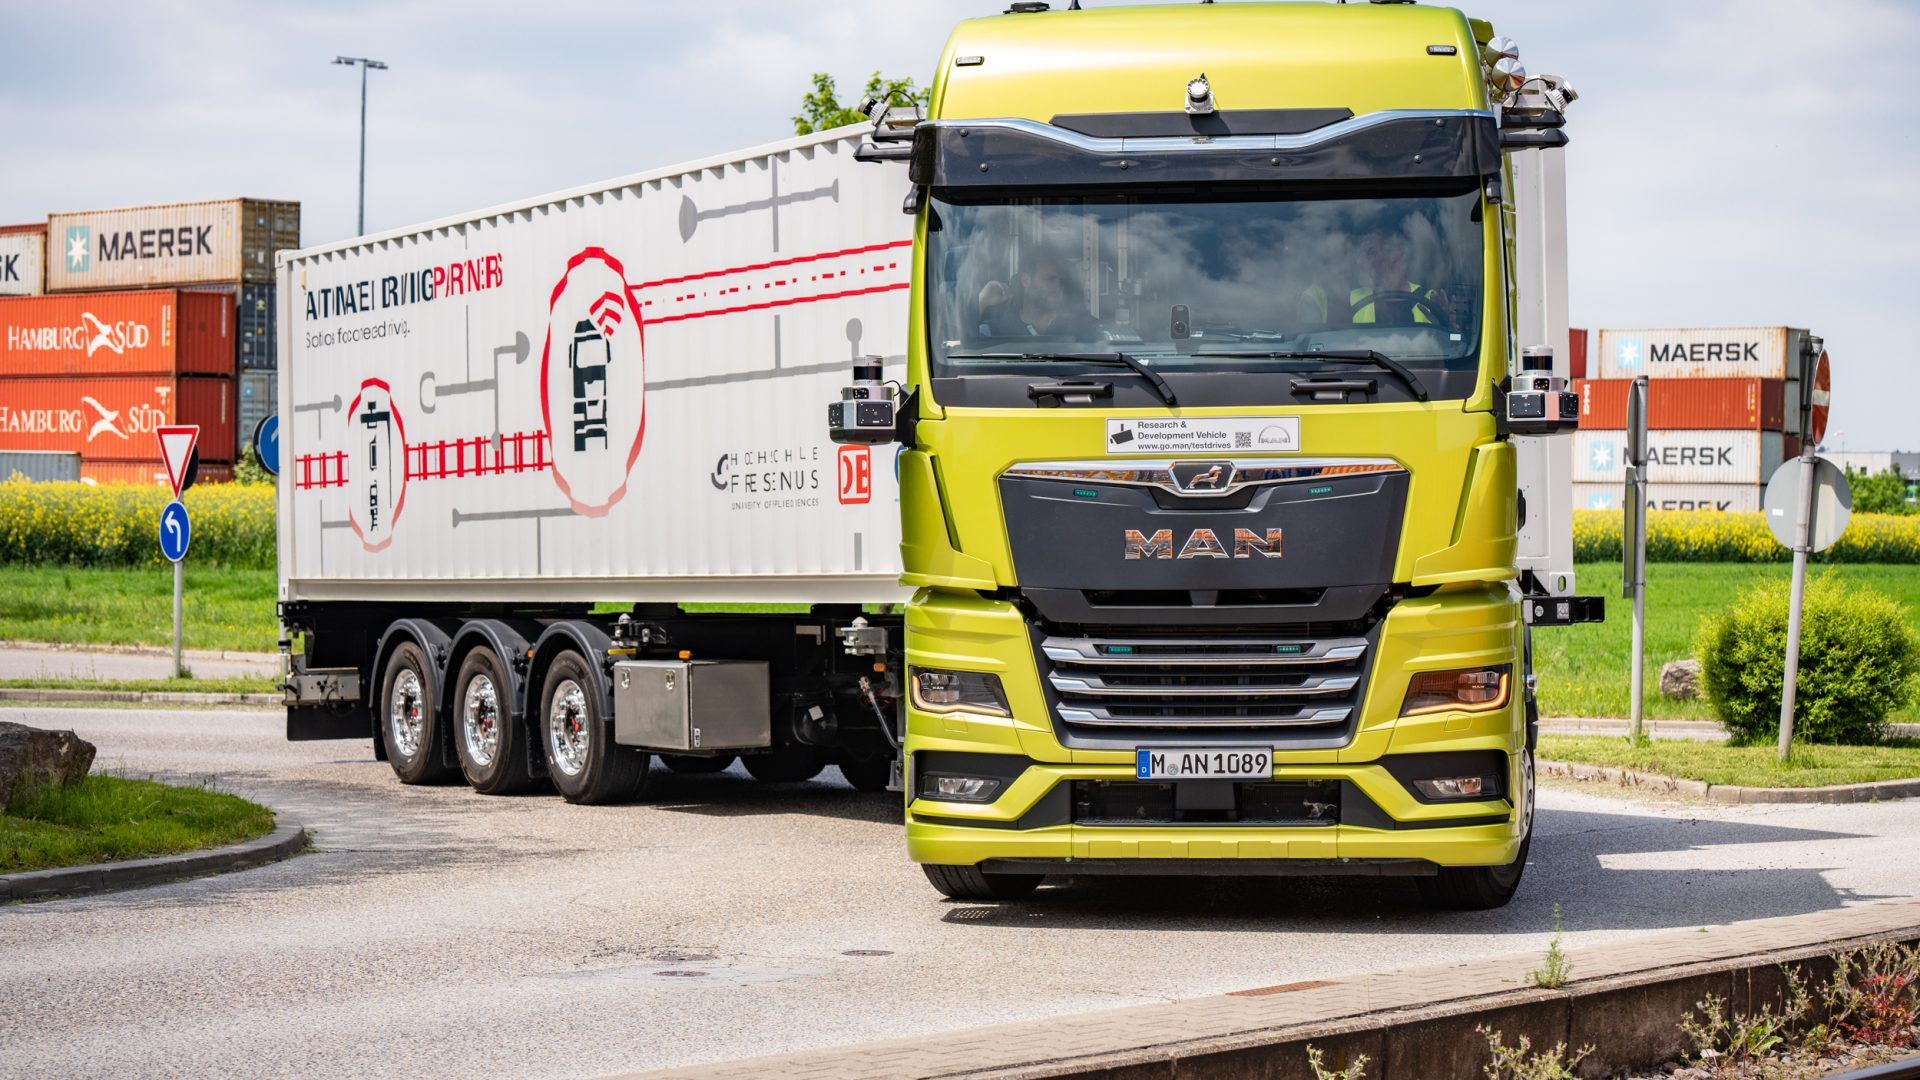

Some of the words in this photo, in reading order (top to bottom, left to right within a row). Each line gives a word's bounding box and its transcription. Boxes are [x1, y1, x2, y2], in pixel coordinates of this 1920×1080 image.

[99, 225, 213, 261] MAERSK
[0, 253, 20, 282] K
[8, 325, 84, 350] HAMBURG
[115, 320, 149, 348] SÜD
[1650, 342, 1759, 362] MAERSK
[129, 403, 165, 433] SÜD
[1137, 421, 1178, 429] Research
[1180, 420, 1187, 428] &
[1137, 432, 1194, 440] Development
[1196, 431, 1227, 439] Vehicle
[1137, 442, 1231, 450] www.go.man/testdrives
[1124, 527, 1283, 560] MAN
[1141, 766, 1147, 774] D
[1151, 753, 1165, 774] M
[1181, 753, 1209, 774] AN
[1213, 753, 1268, 774] 1089
